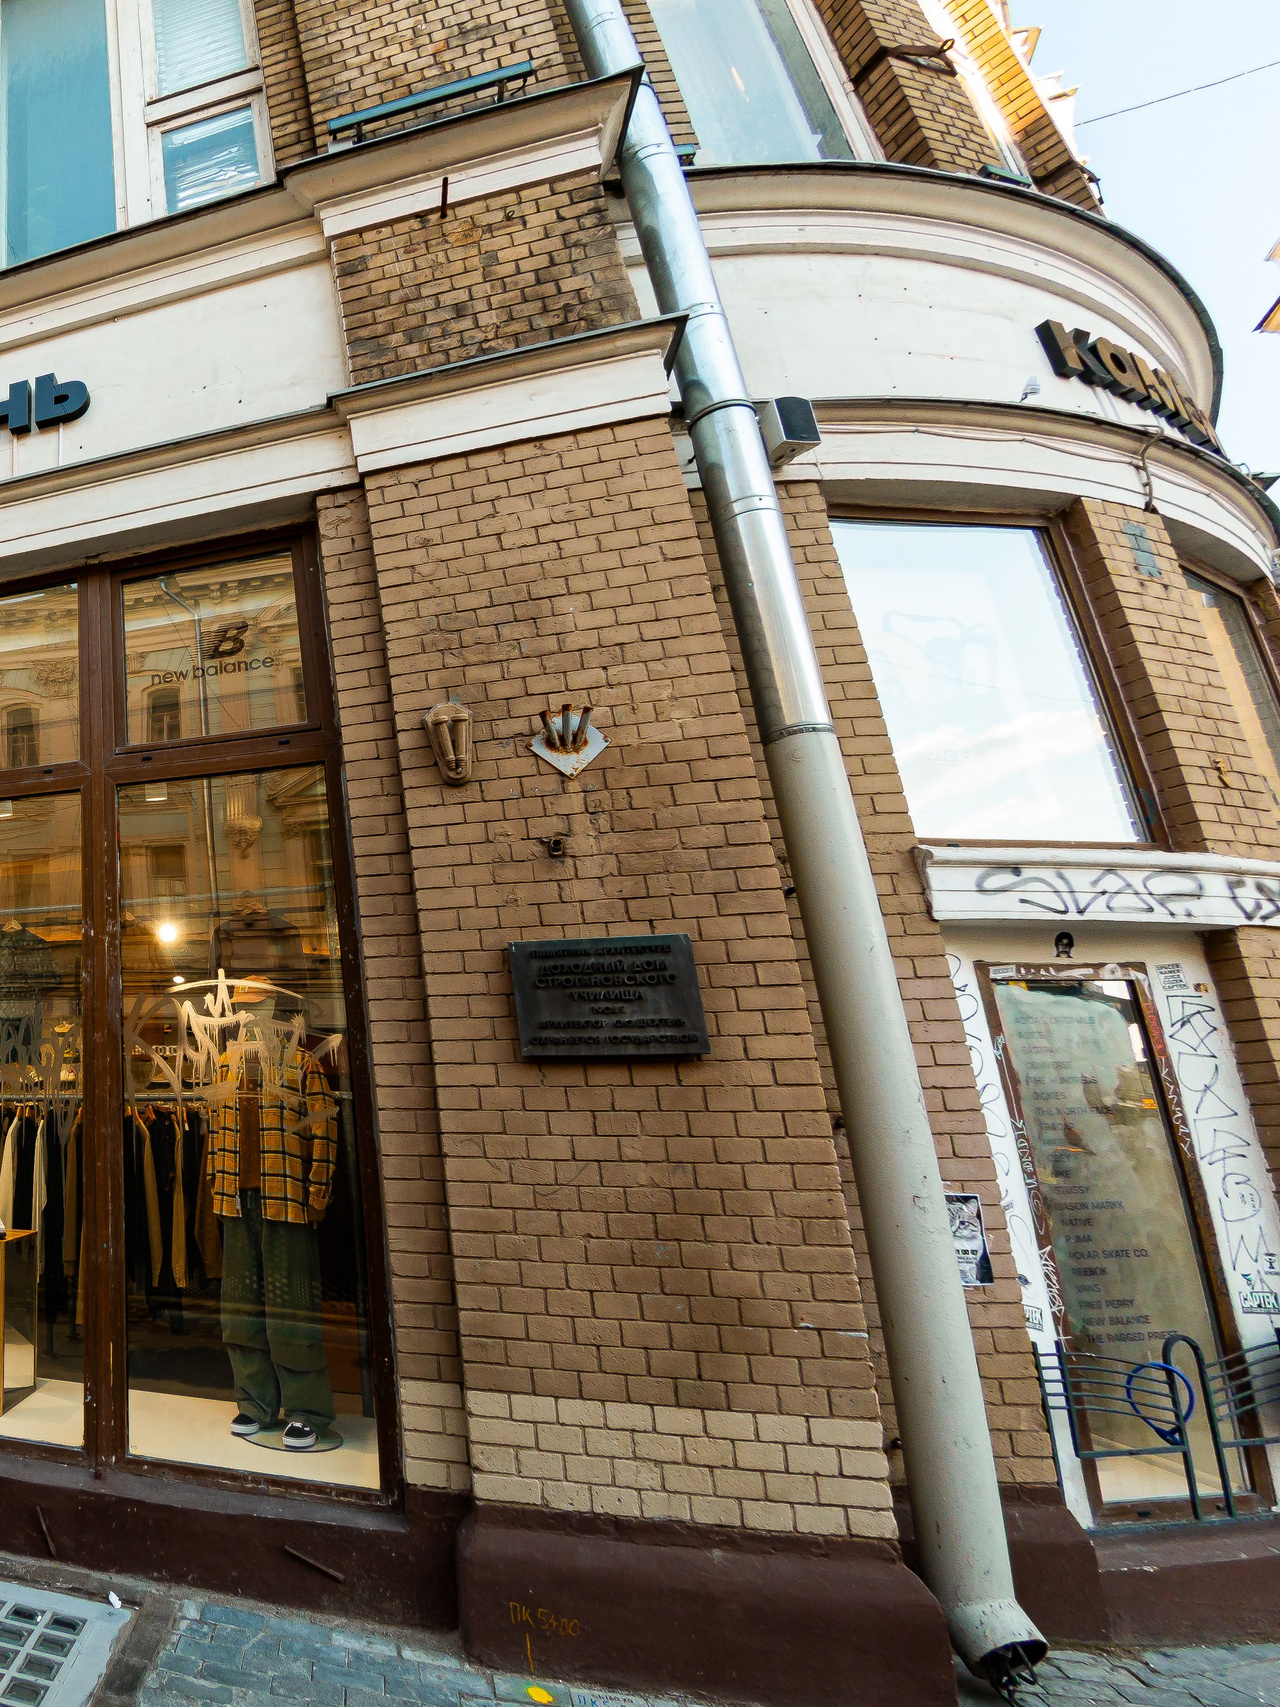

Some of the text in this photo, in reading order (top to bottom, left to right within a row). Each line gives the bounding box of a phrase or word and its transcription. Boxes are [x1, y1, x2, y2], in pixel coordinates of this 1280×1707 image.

[151, 656, 274, 686] new balance
[540, 959, 668, 975] ДОХОДНЫЙ ДОМ
[535, 973, 677, 987] СТРОГАНОВСКОГО
[571, 989, 643, 1000] УЧИЛИЩА
[1061, 1217, 1094, 1227] NATIVE
[1068, 1250, 1100, 1260] POLAR
[1102, 1249, 1131, 1259] SKATE
[1071, 1266, 1107, 1277] REEBOK
[1075, 1283, 1101, 1293] VANS
[1083, 1315, 1151, 1326] NEW BALANCE
[1086, 1334, 1105, 1343] THE
